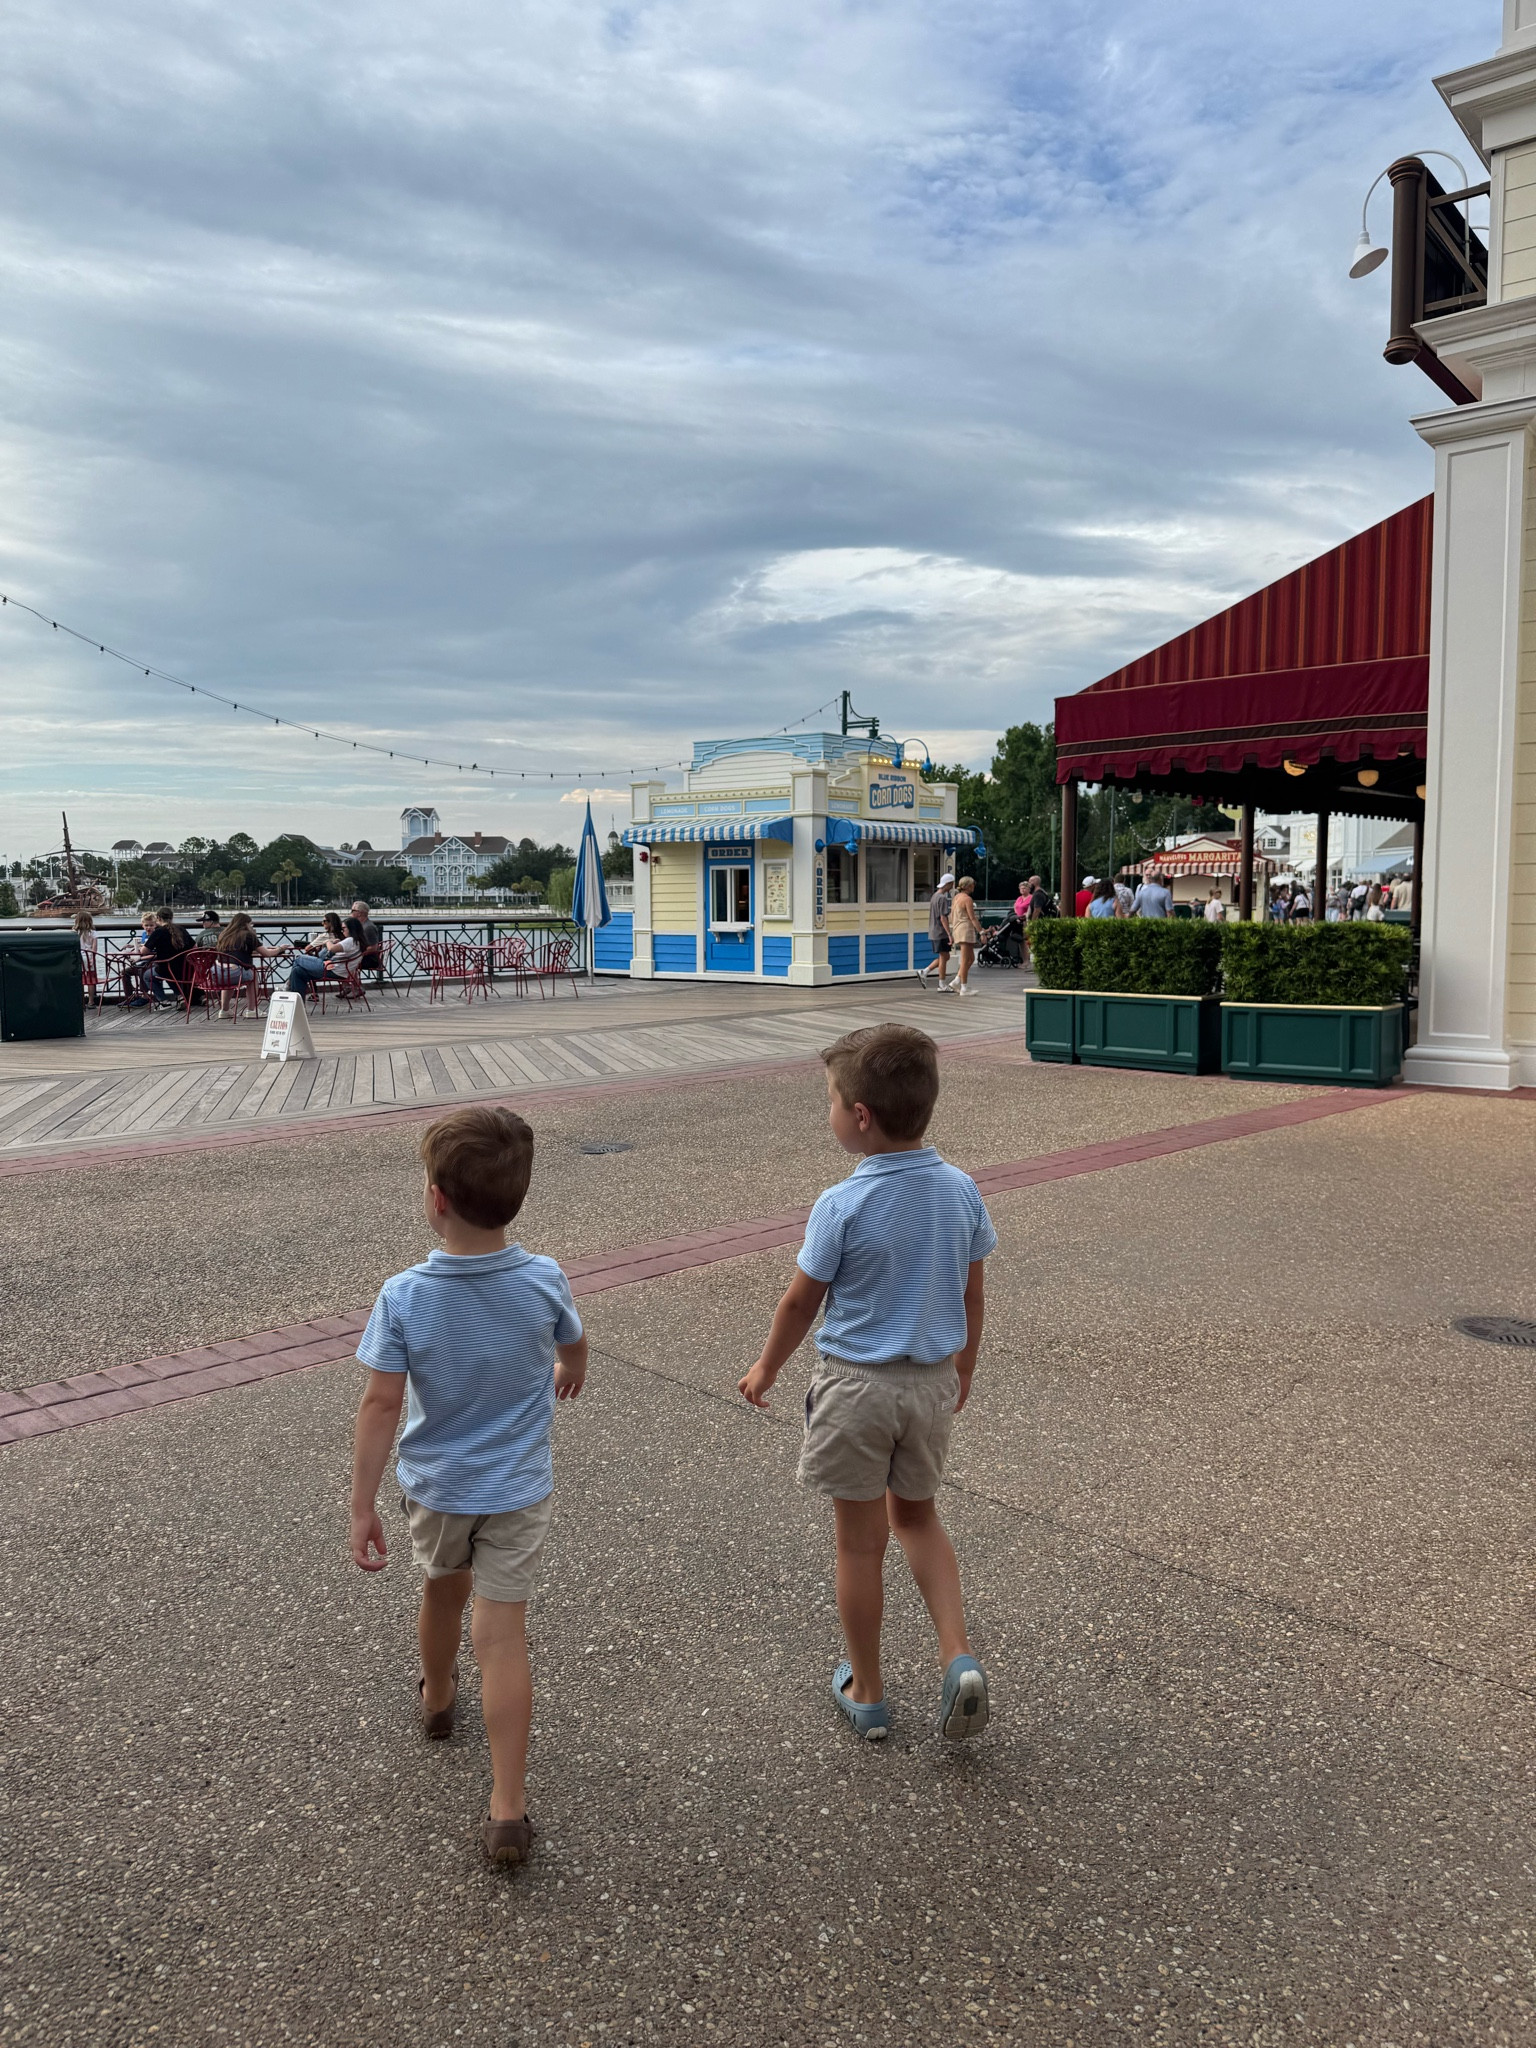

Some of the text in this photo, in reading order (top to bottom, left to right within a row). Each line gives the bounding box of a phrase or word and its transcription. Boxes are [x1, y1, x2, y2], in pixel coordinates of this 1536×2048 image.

[872, 786, 913, 807] CORN DOGS
[711, 848, 749, 857] ORDER
[1159, 853, 1187, 862] MARVELOUS
[270, 1020, 288, 1030] CAUTION
